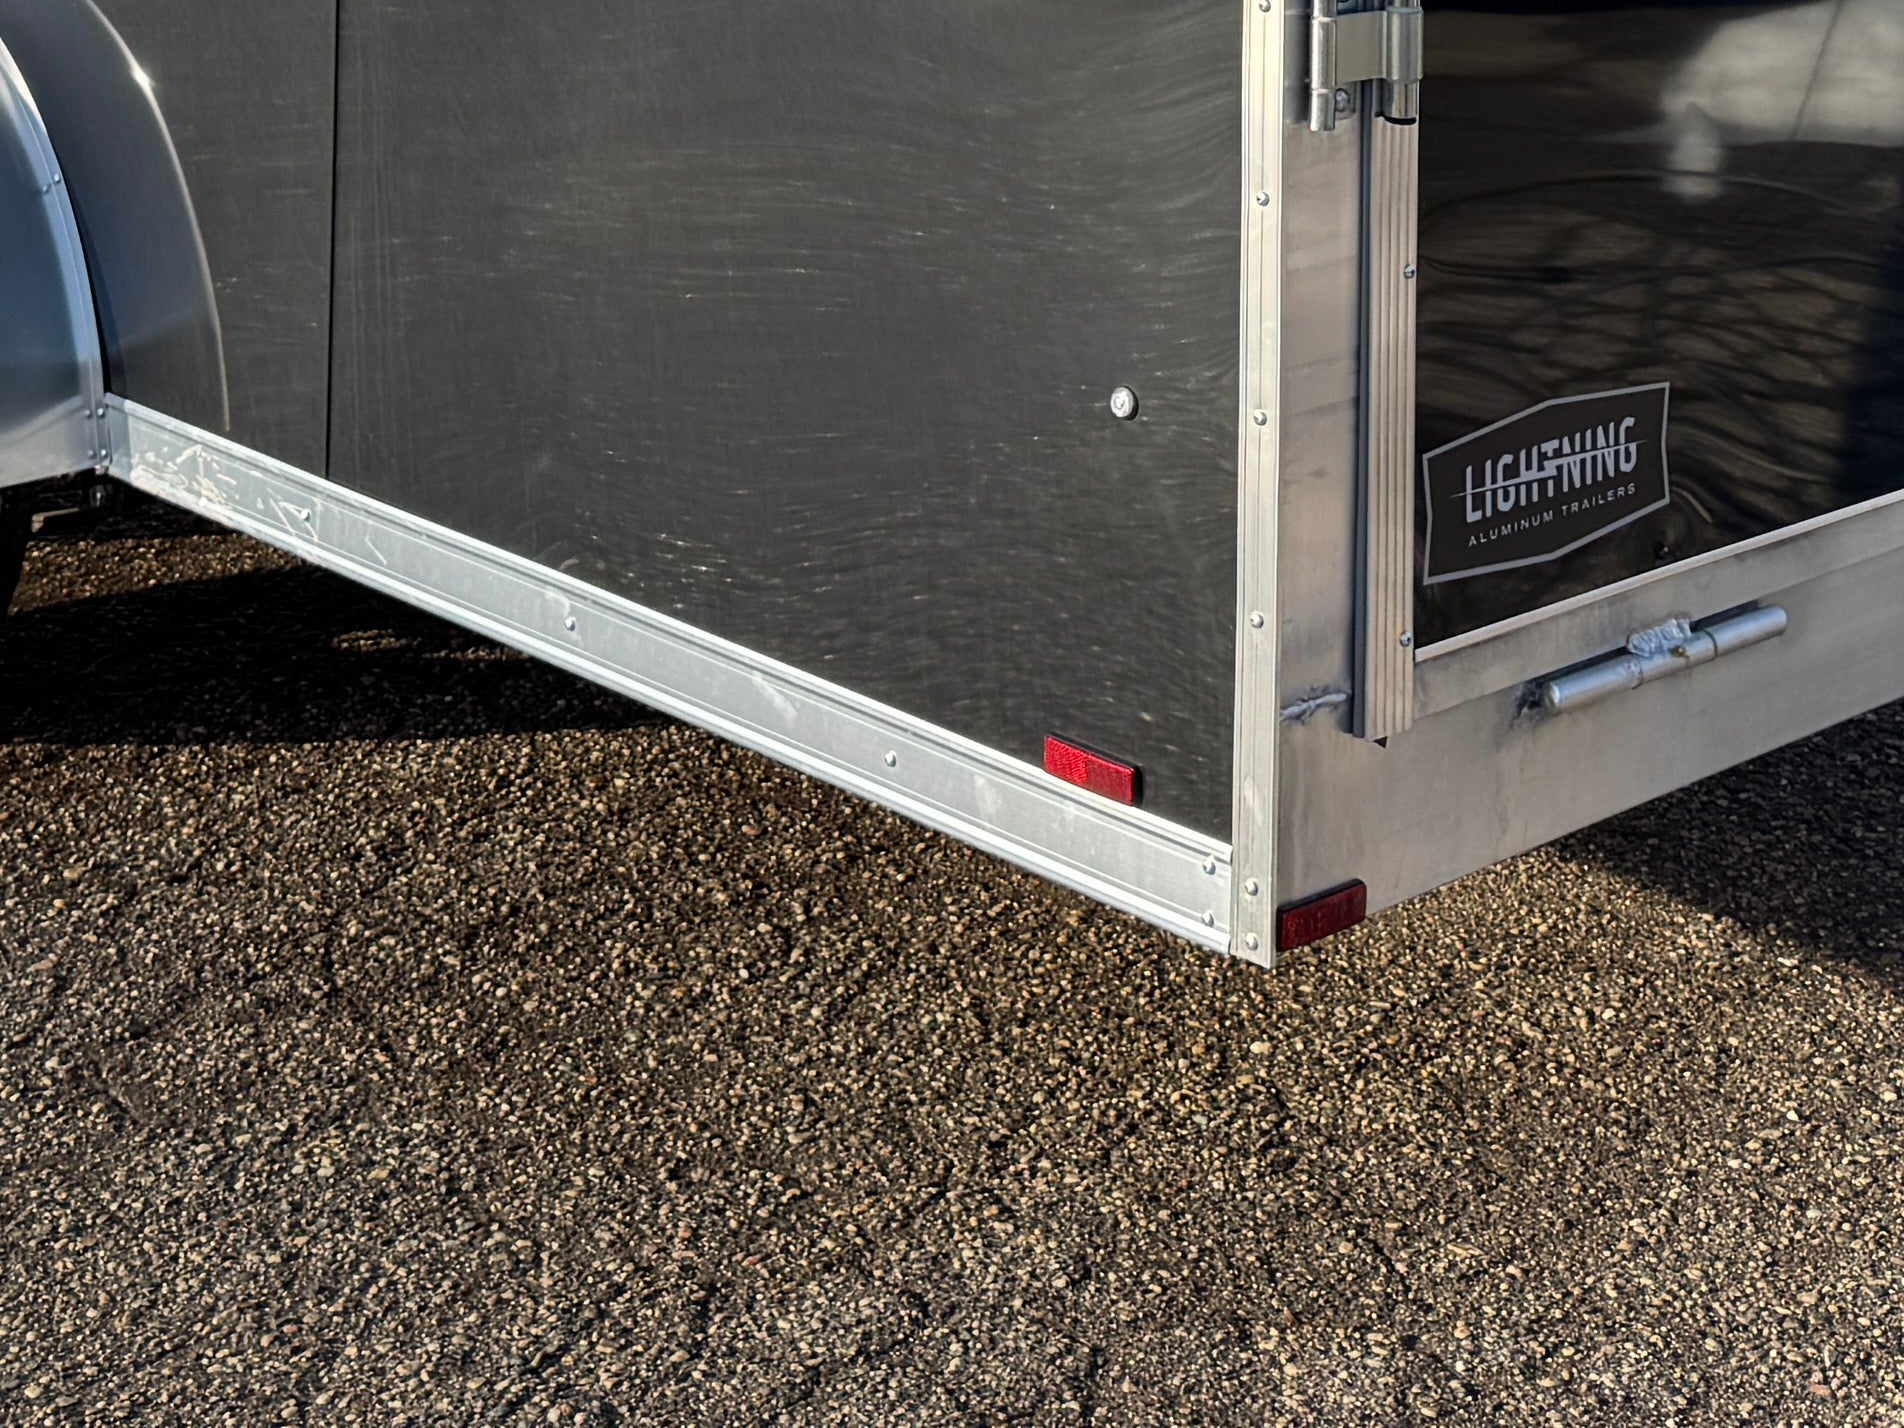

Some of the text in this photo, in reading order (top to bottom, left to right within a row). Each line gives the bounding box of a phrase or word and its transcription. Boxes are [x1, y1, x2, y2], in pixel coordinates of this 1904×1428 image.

[1465, 416, 1638, 524] LIGHTNING
[1468, 482, 1636, 547] ALUMINUM TRAILERS
